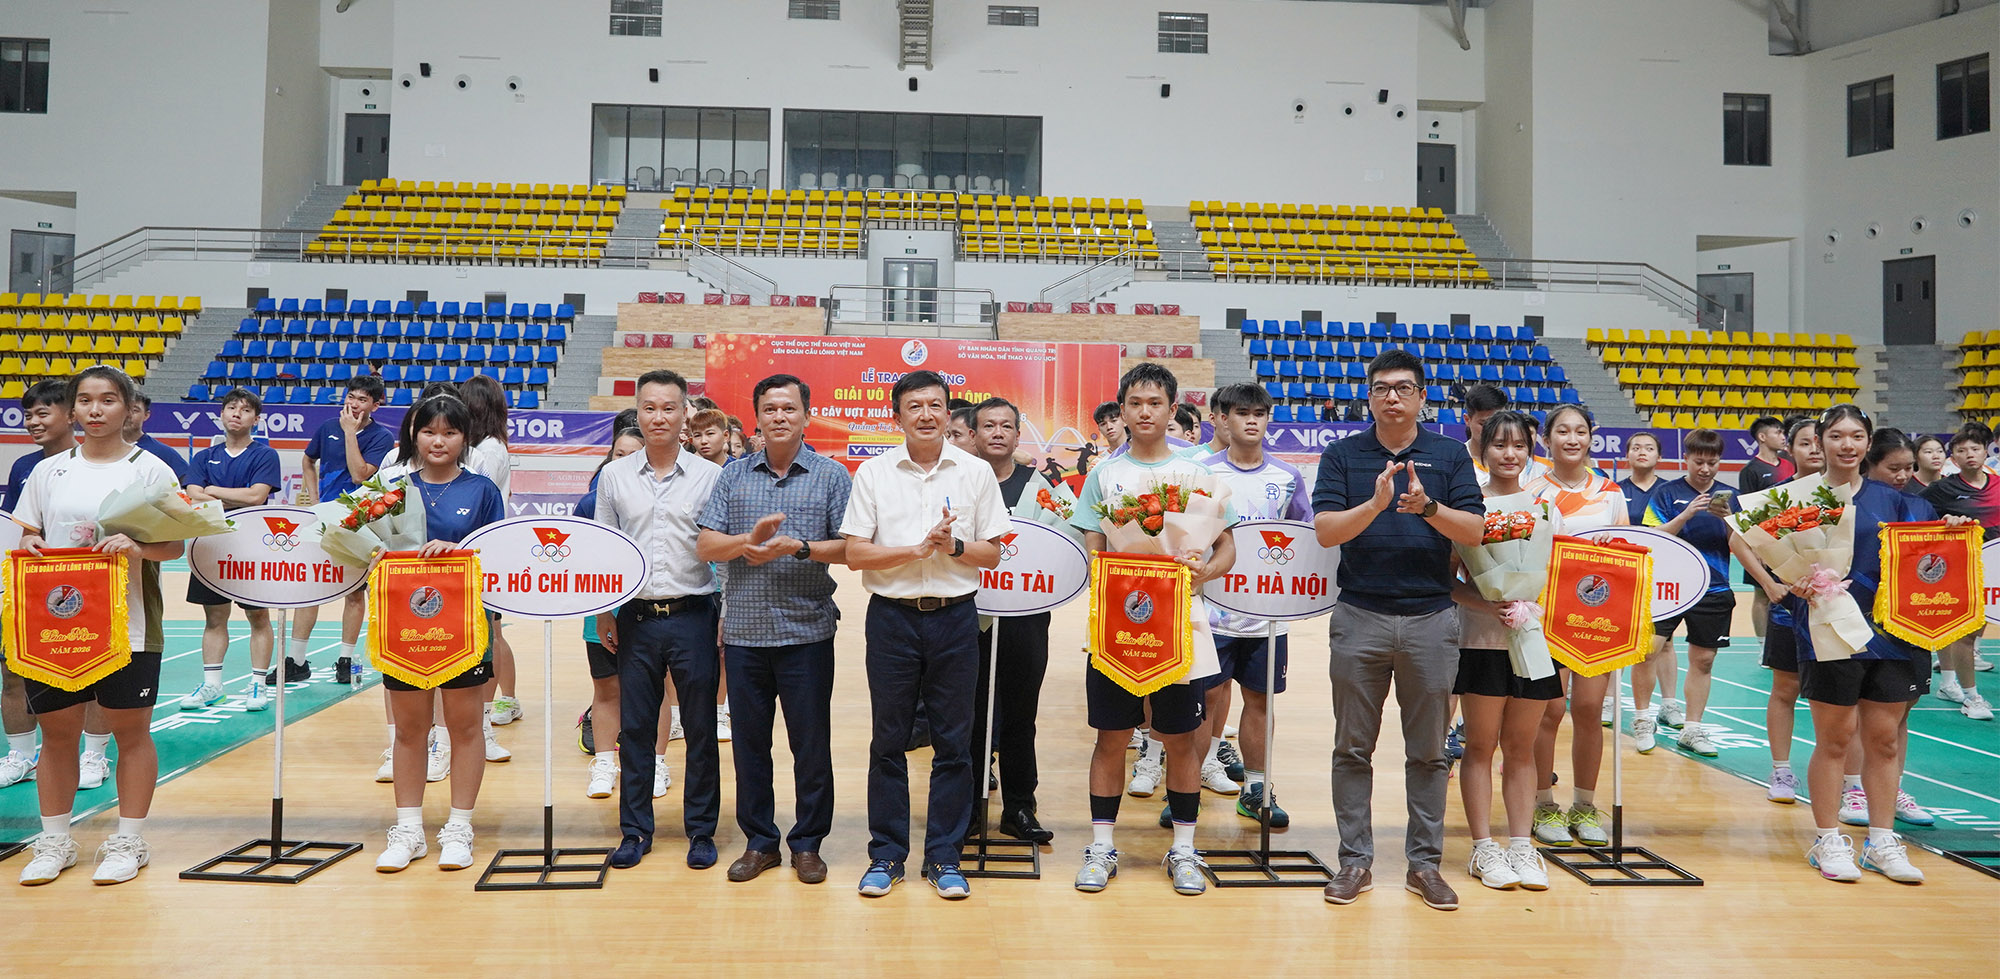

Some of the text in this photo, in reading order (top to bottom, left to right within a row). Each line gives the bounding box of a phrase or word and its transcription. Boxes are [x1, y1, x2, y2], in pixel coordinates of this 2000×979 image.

[861, 368, 875, 383] LỄ
[834, 385, 862, 400] GIẢI
[866, 387, 884, 401] VÔ
[821, 406, 842, 417] CÂY
[867, 405, 893, 418] XUẤT
[1563, 551, 1574, 560] LIÊN
[26, 564, 38, 573] LIÊN
[83, 562, 94, 572] VIỆT
[95, 562, 108, 570] NAM
[218, 554, 344, 583] TỈNH HƯNG YÊN
[441, 565, 452, 574] VIỆT
[1110, 567, 1120, 575] LIÊN
[508, 566, 532, 593] HỒ
[538, 569, 568, 593] CHÍ
[575, 574, 623, 593] MINH
[1021, 570, 1054, 593] TÀI
[1222, 571, 1328, 600] TP. HÀ NỘI
[1656, 582, 1680, 605] TRỊ
[1593, 635, 1611, 643] 2026
